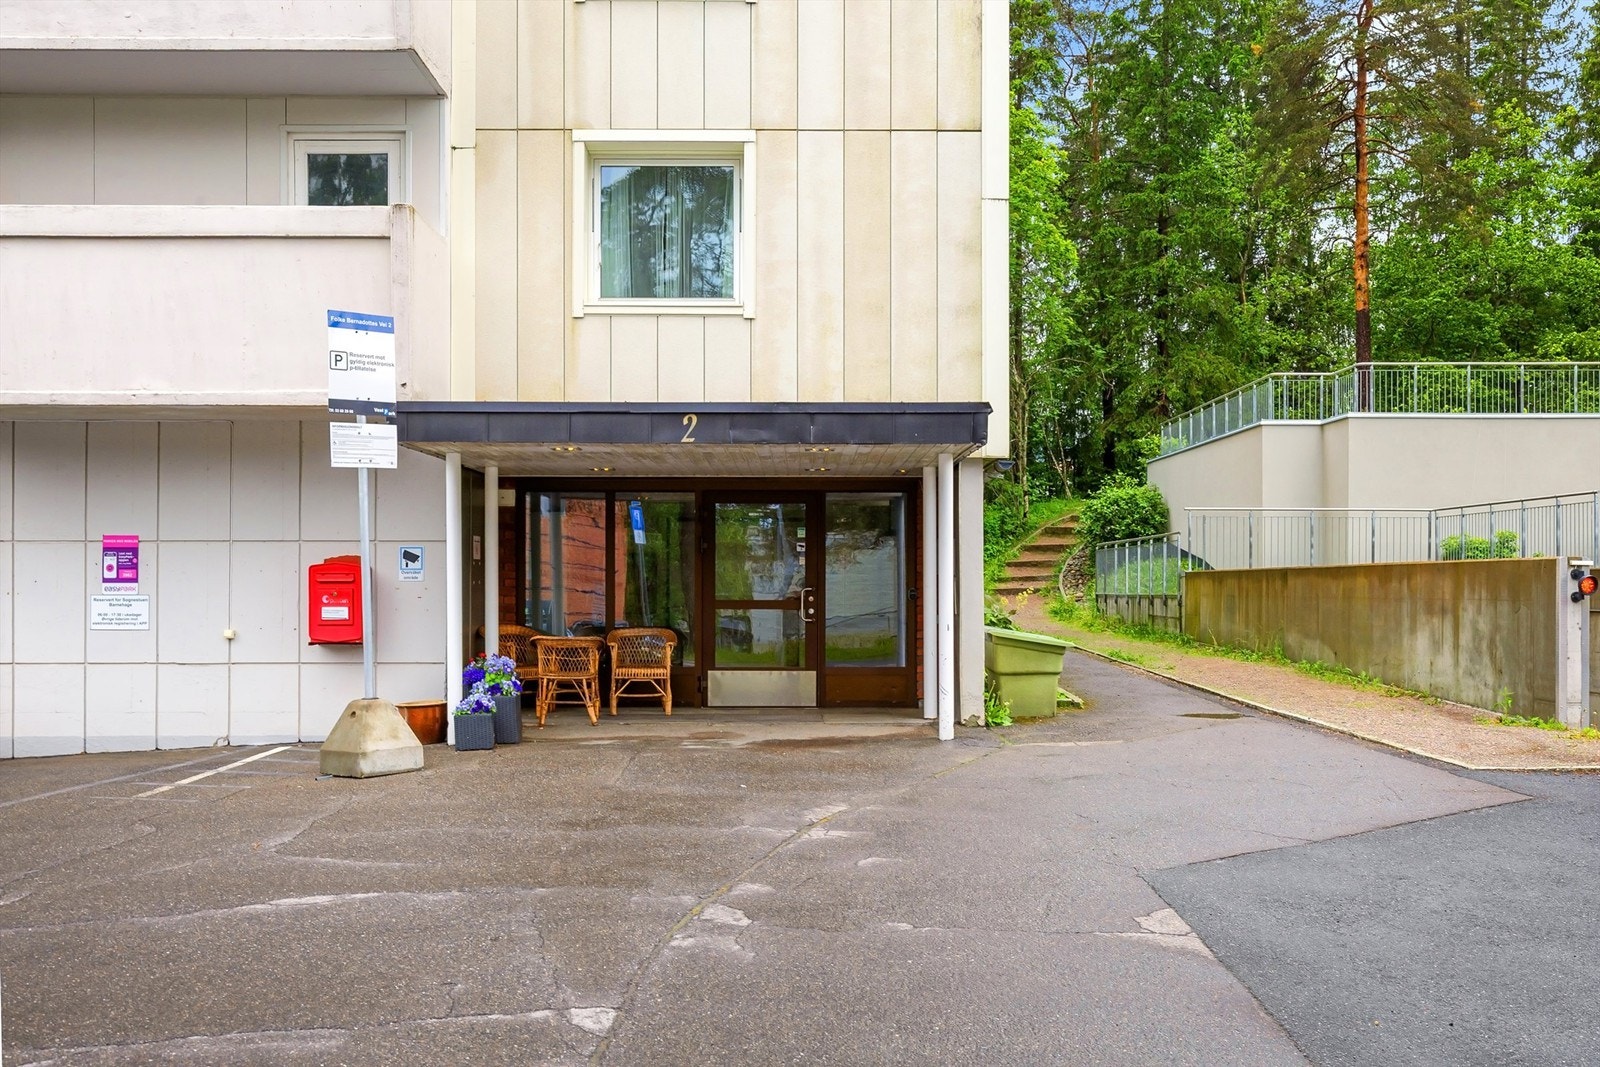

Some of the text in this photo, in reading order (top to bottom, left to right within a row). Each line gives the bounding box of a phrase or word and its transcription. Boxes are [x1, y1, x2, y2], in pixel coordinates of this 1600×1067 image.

[330, 315, 346, 323] Folke
[346, 317, 378, 327] Bernadottes
[334, 354, 343, 367] P
[349, 351, 374, 359] Reservert
[367, 360, 395, 368] elektronisk
[680, 413, 698, 443] 2
